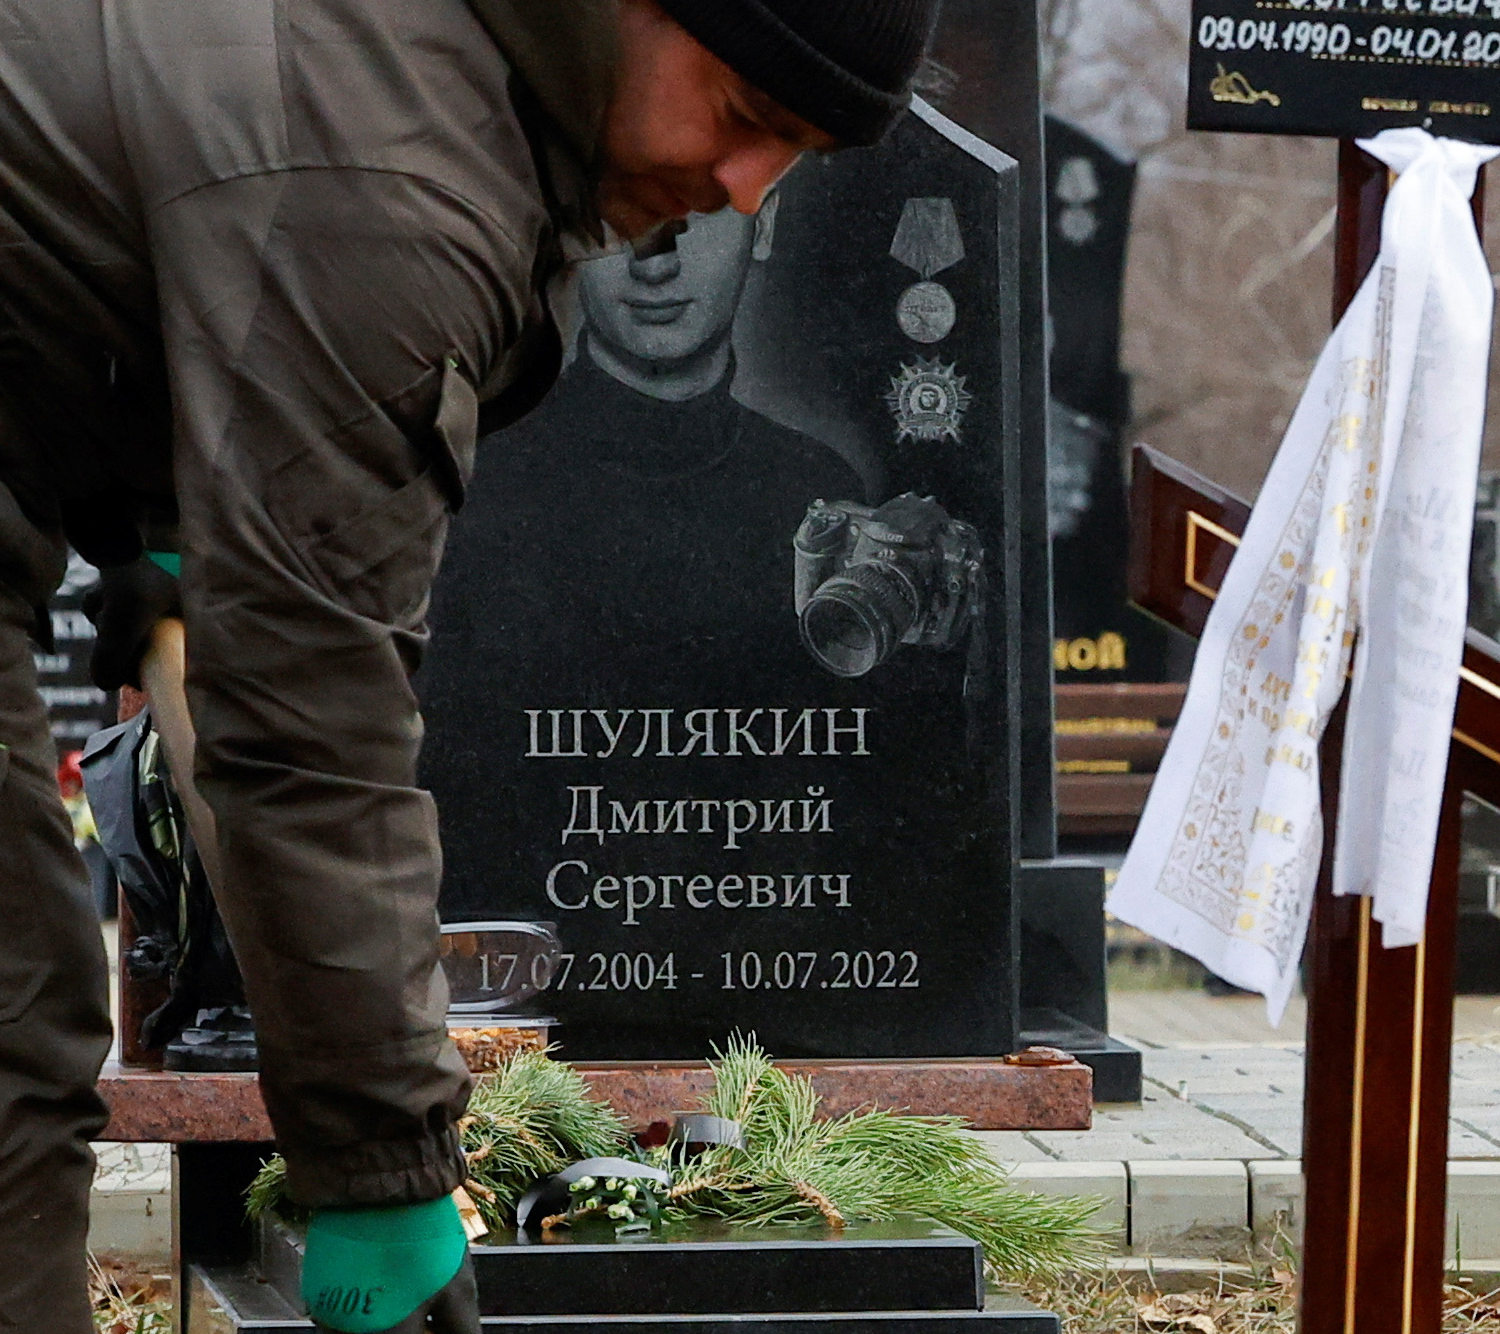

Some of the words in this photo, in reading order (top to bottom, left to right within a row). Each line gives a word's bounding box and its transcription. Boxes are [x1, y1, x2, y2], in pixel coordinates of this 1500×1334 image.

[523, 707, 871, 758] ШУЛЯКИН
[561, 785, 834, 850] Дмитрий
[545, 860, 853, 925] Сергеевич
[478, 951, 679, 991] 17.07.2004
[720, 950, 920, 990] 10.07.2022
